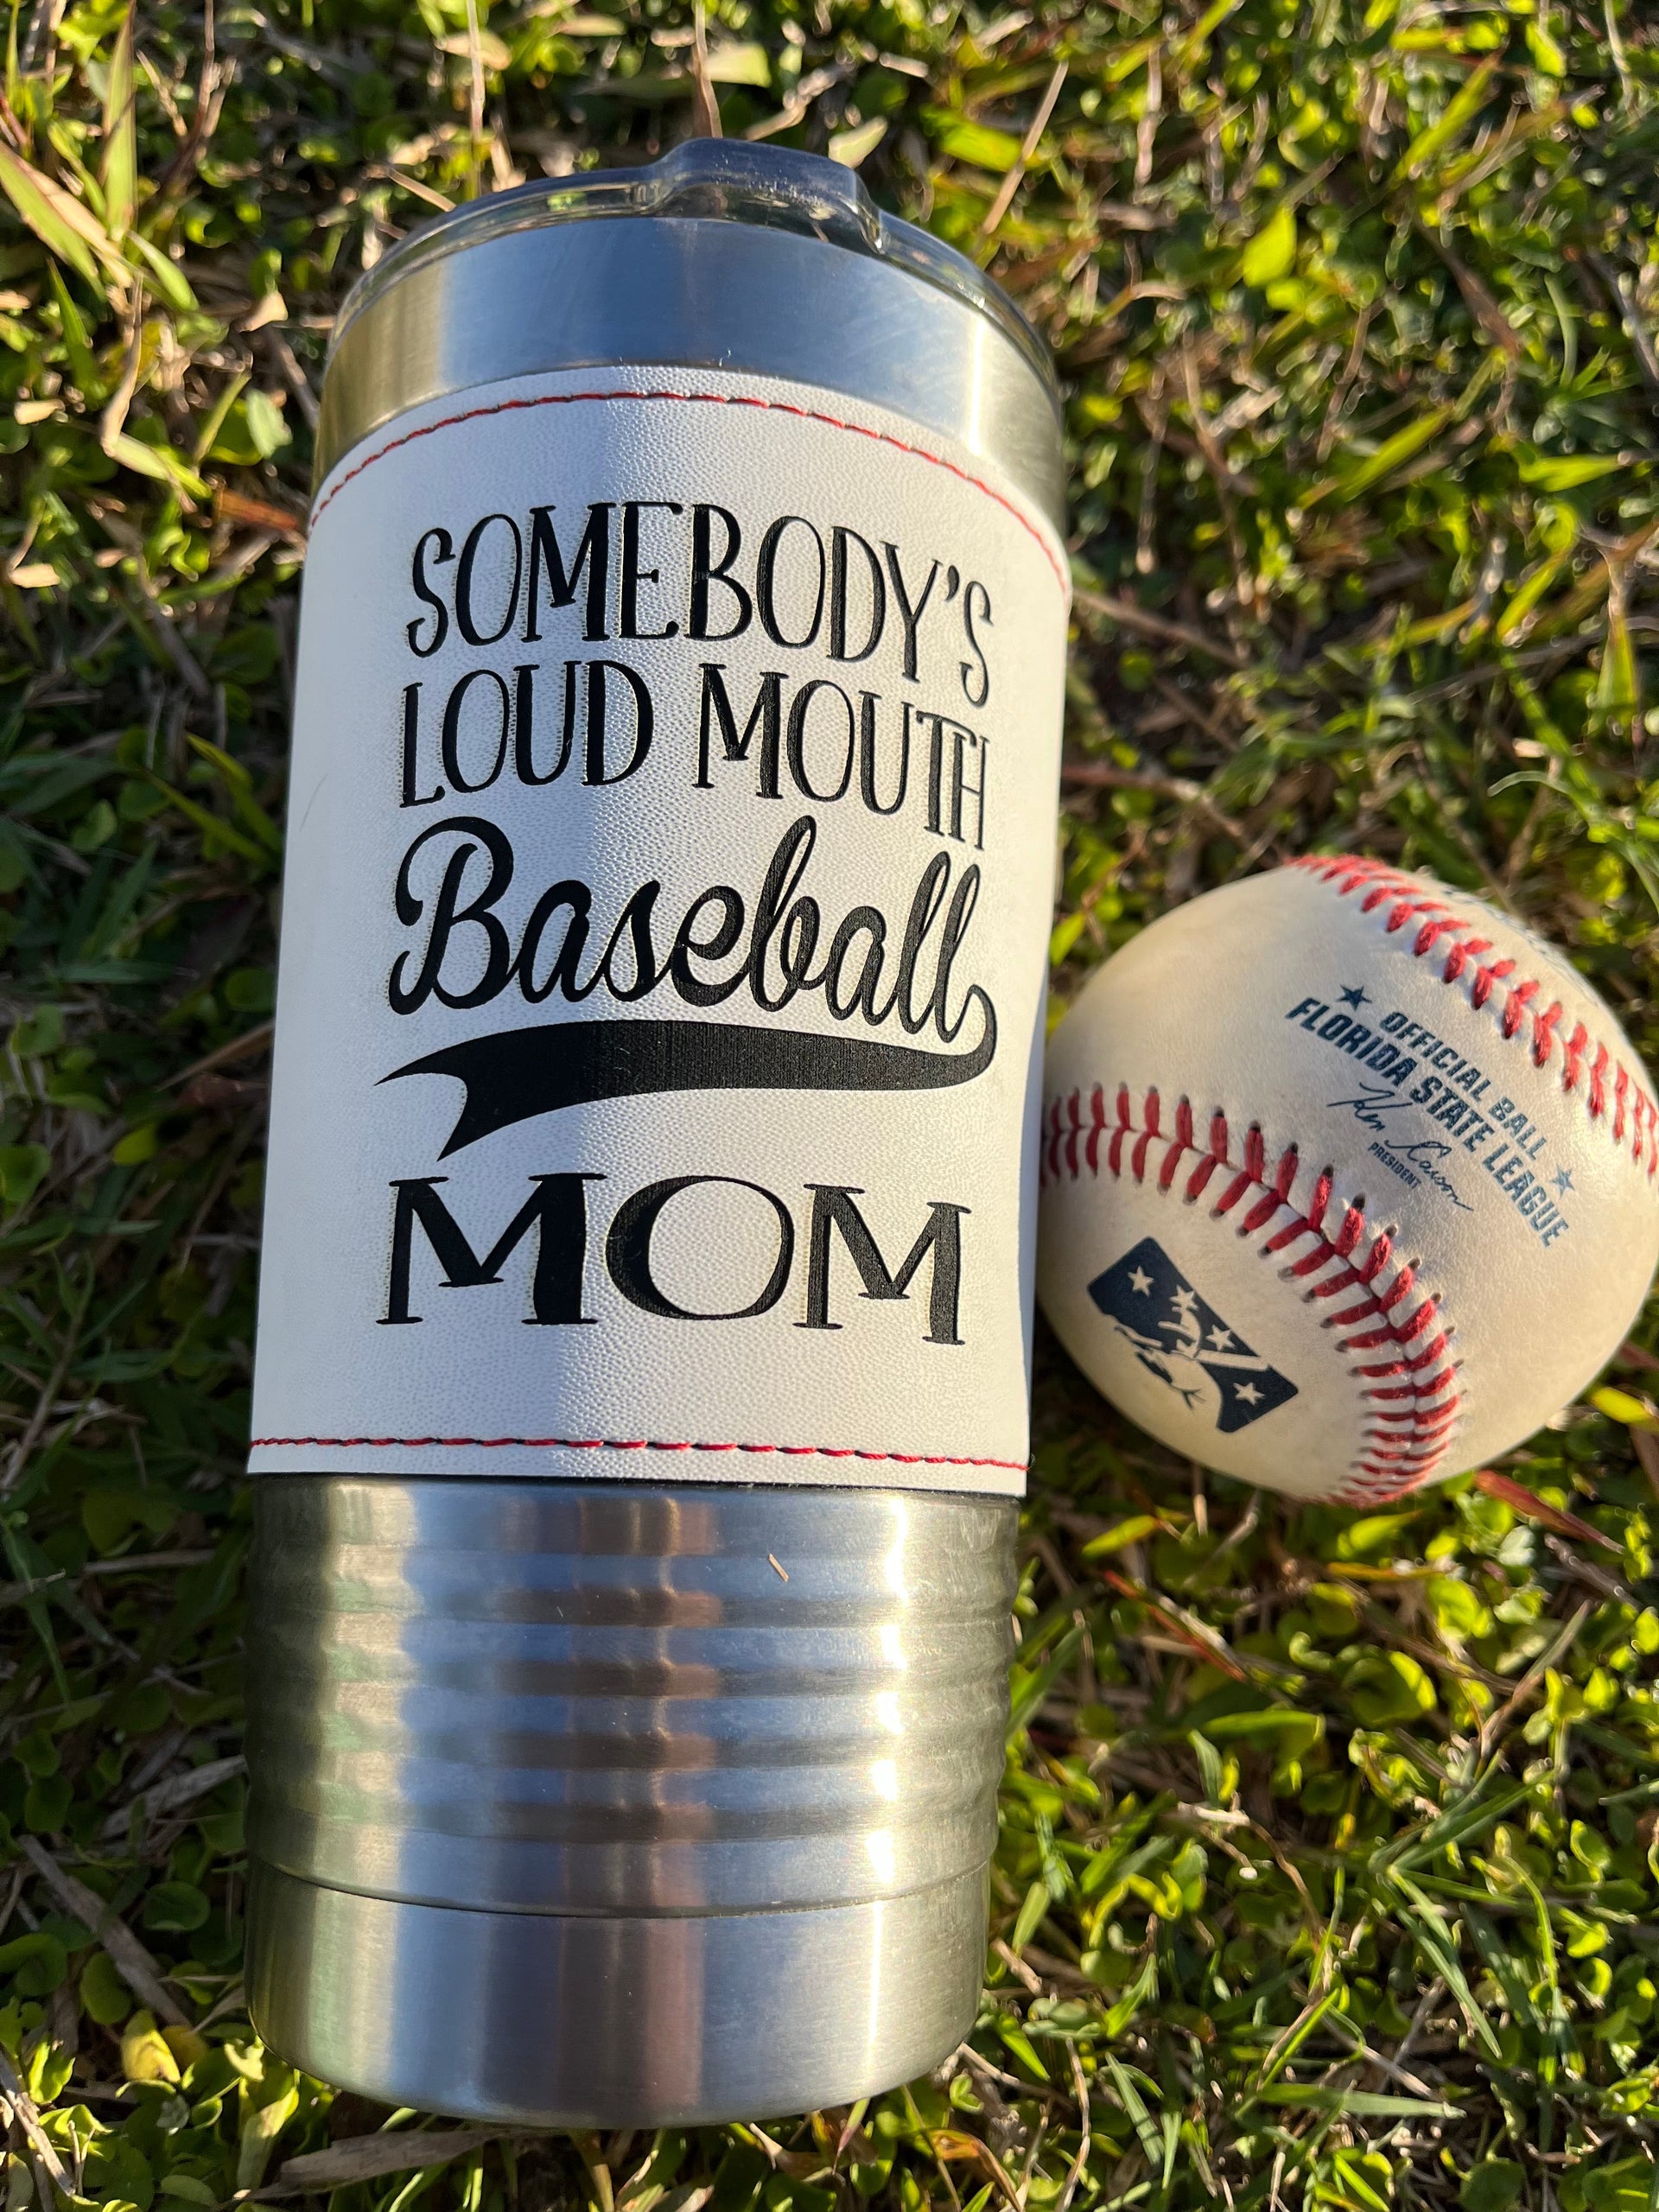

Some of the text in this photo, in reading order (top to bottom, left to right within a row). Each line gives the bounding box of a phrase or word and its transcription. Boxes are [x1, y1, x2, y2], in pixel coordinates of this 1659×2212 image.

[406, 500, 992, 709] SOMEBODY'S
[400, 660, 989, 850] LOUD MOUTH
[389, 815, 982, 1044] Baseball
[1284, 996, 1569, 1248] FLORIDA STATE LEAGUE
[1367, 1141, 1422, 1190] PRESIDENT
[1379, 1011, 1548, 1162] OFFICIAL BALL
[376, 1173, 973, 1345] MOM
